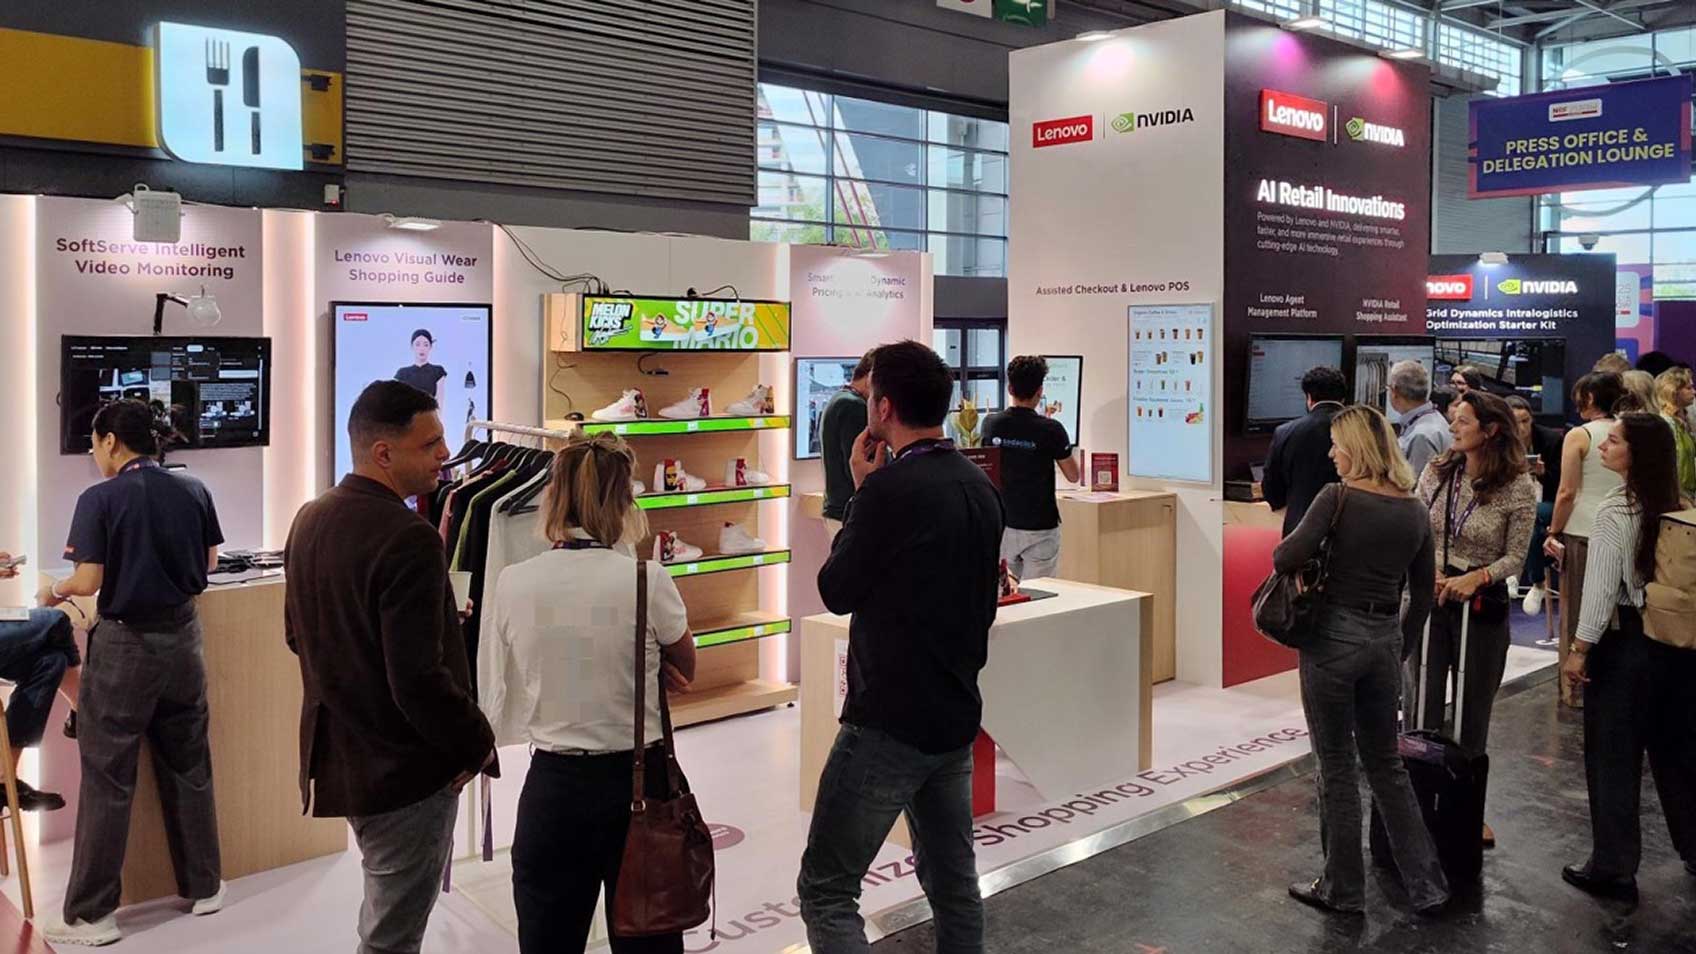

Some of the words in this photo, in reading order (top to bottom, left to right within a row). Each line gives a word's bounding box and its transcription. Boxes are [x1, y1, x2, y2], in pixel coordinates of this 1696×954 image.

[1268, 98, 1324, 132] Lenovo
[1037, 124, 1088, 142] Lenovo
[1506, 136, 1560, 155] PRESS
[1563, 129, 1628, 148] OFFICE
[1632, 127, 1649, 142] &
[1483, 150, 1592, 174] DELEGATION
[1597, 143, 1675, 163] LOUNGE
[1257, 179, 1276, 203] AI
[1279, 182, 1324, 209] Retail
[1327, 189, 1405, 220] Innovations
[1257, 211, 1285, 223] Powered
[1286, 215, 1294, 226] by
[1295, 216, 1317, 226] Lenovo
[1318, 219, 1329, 228] and
[1278, 228, 1289, 237] and
[1290, 230, 1306, 239] more
[56, 238, 149, 255] SoftServe
[155, 242, 246, 260] Intelligent
[335, 249, 390, 264] Lenovo
[394, 252, 437, 265] Visual
[441, 254, 478, 267] Wear
[75, 260, 130, 275] Video
[137, 262, 235, 280] Monitoring
[349, 269, 419, 284] Shopping
[424, 271, 465, 284] Guide
[1036, 285, 1073, 296] Assisted
[1074, 284, 1118, 295] Checkout
[1120, 284, 1127, 293] &
[1129, 283, 1166, 293] Lenovo
[1168, 280, 1190, 292] POS
[1260, 293, 1284, 304] Lenovo
[1285, 294, 1305, 306] Agent
[592, 303, 631, 318] MELON
[675, 300, 756, 325] SUPER
[1247, 307, 1289, 319] Management
[1290, 308, 1317, 319] Platform
[1356, 311, 1382, 323] Shopping
[1450, 309, 1503, 320] Dynamics
[1506, 309, 1579, 320] Intralogistics
[1426, 320, 1497, 331] Optimization
[1499, 320, 1537, 330] Starter
[1540, 320, 1557, 330] Kit
[972, 782, 1154, 846] Shopping
[1136, 727, 1309, 786] Experience
